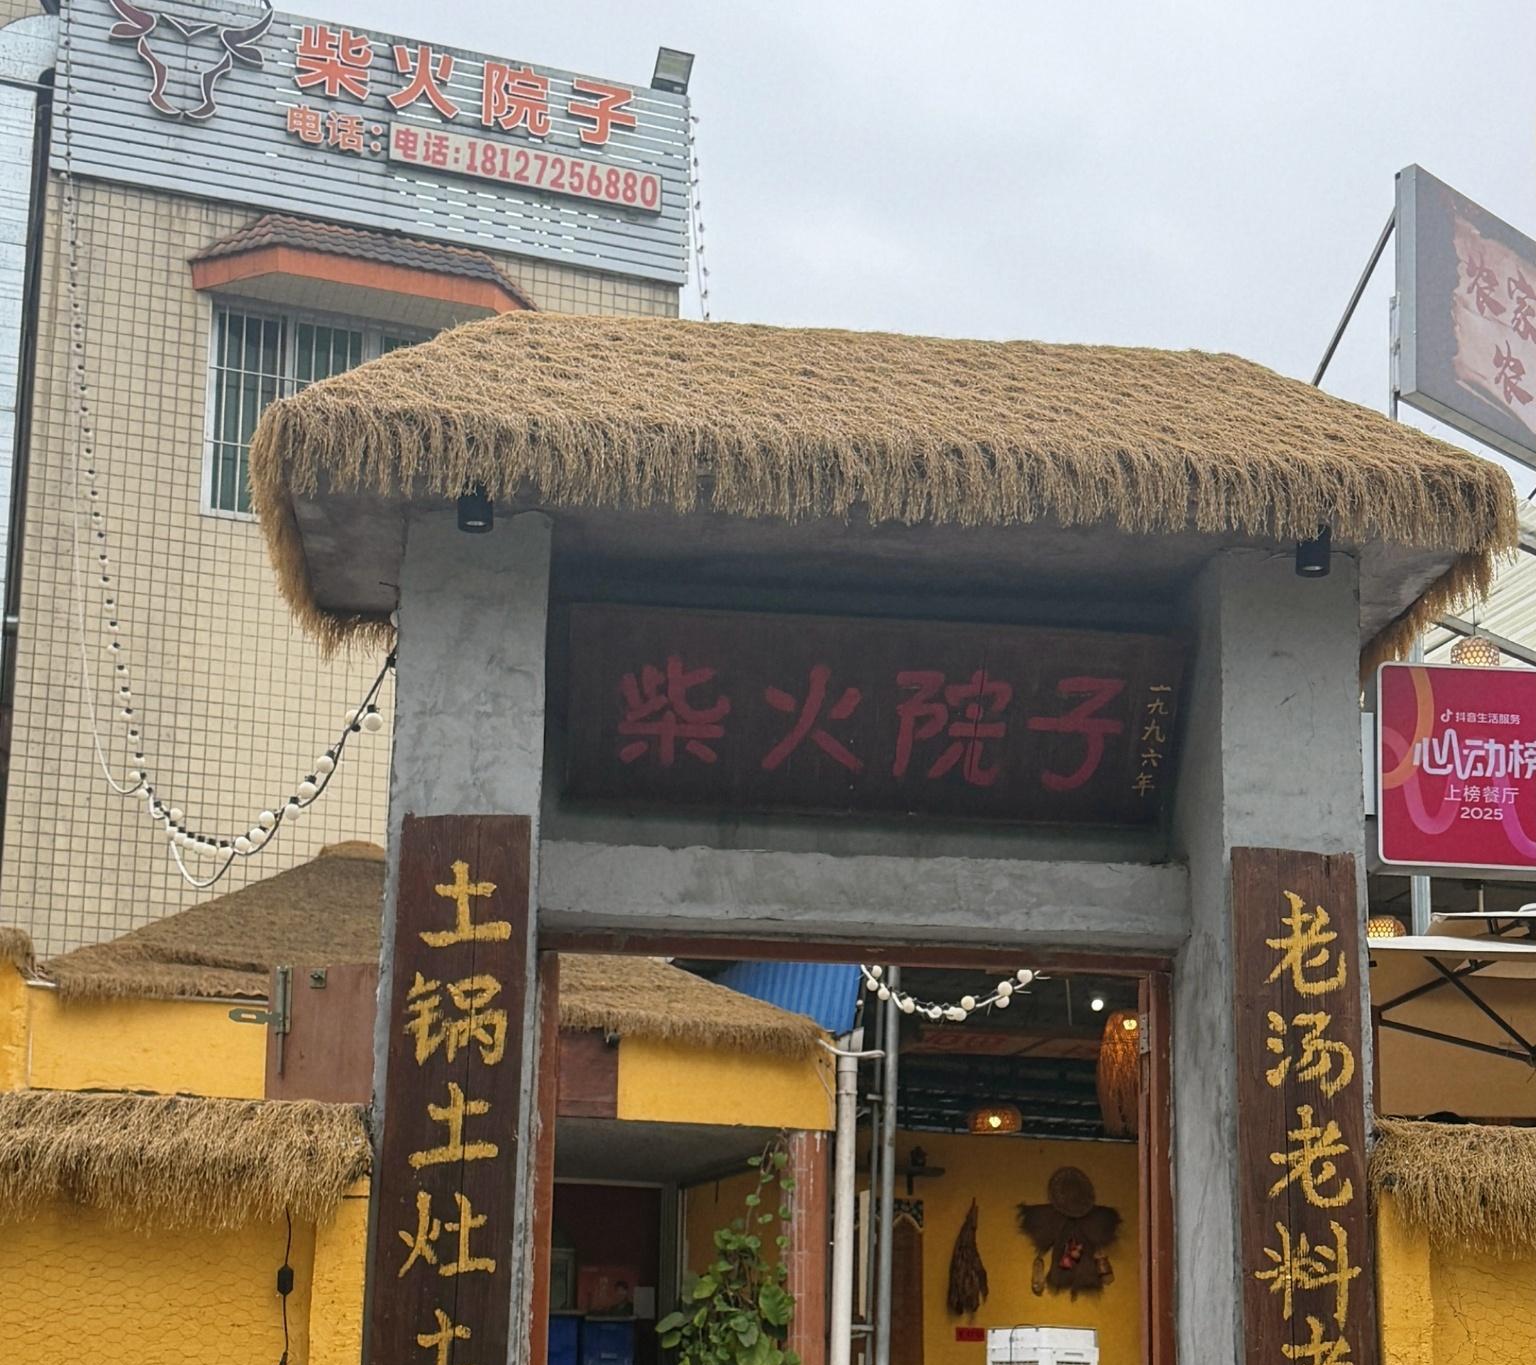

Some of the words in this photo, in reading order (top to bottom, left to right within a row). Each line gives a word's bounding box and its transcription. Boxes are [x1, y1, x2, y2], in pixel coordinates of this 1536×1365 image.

[294, 23, 638, 146] 柴火院子
[393, 127, 658, 210] 电话:18127256880
[617, 653, 1128, 791] 柴火院子
[1131, 684, 1172, 797] 一九九六年
[1455, 711, 1521, 725] 抖音生活服务
[1444, 784, 1520, 805] 上榜餐厅
[1460, 806, 1504, 821] 2025
